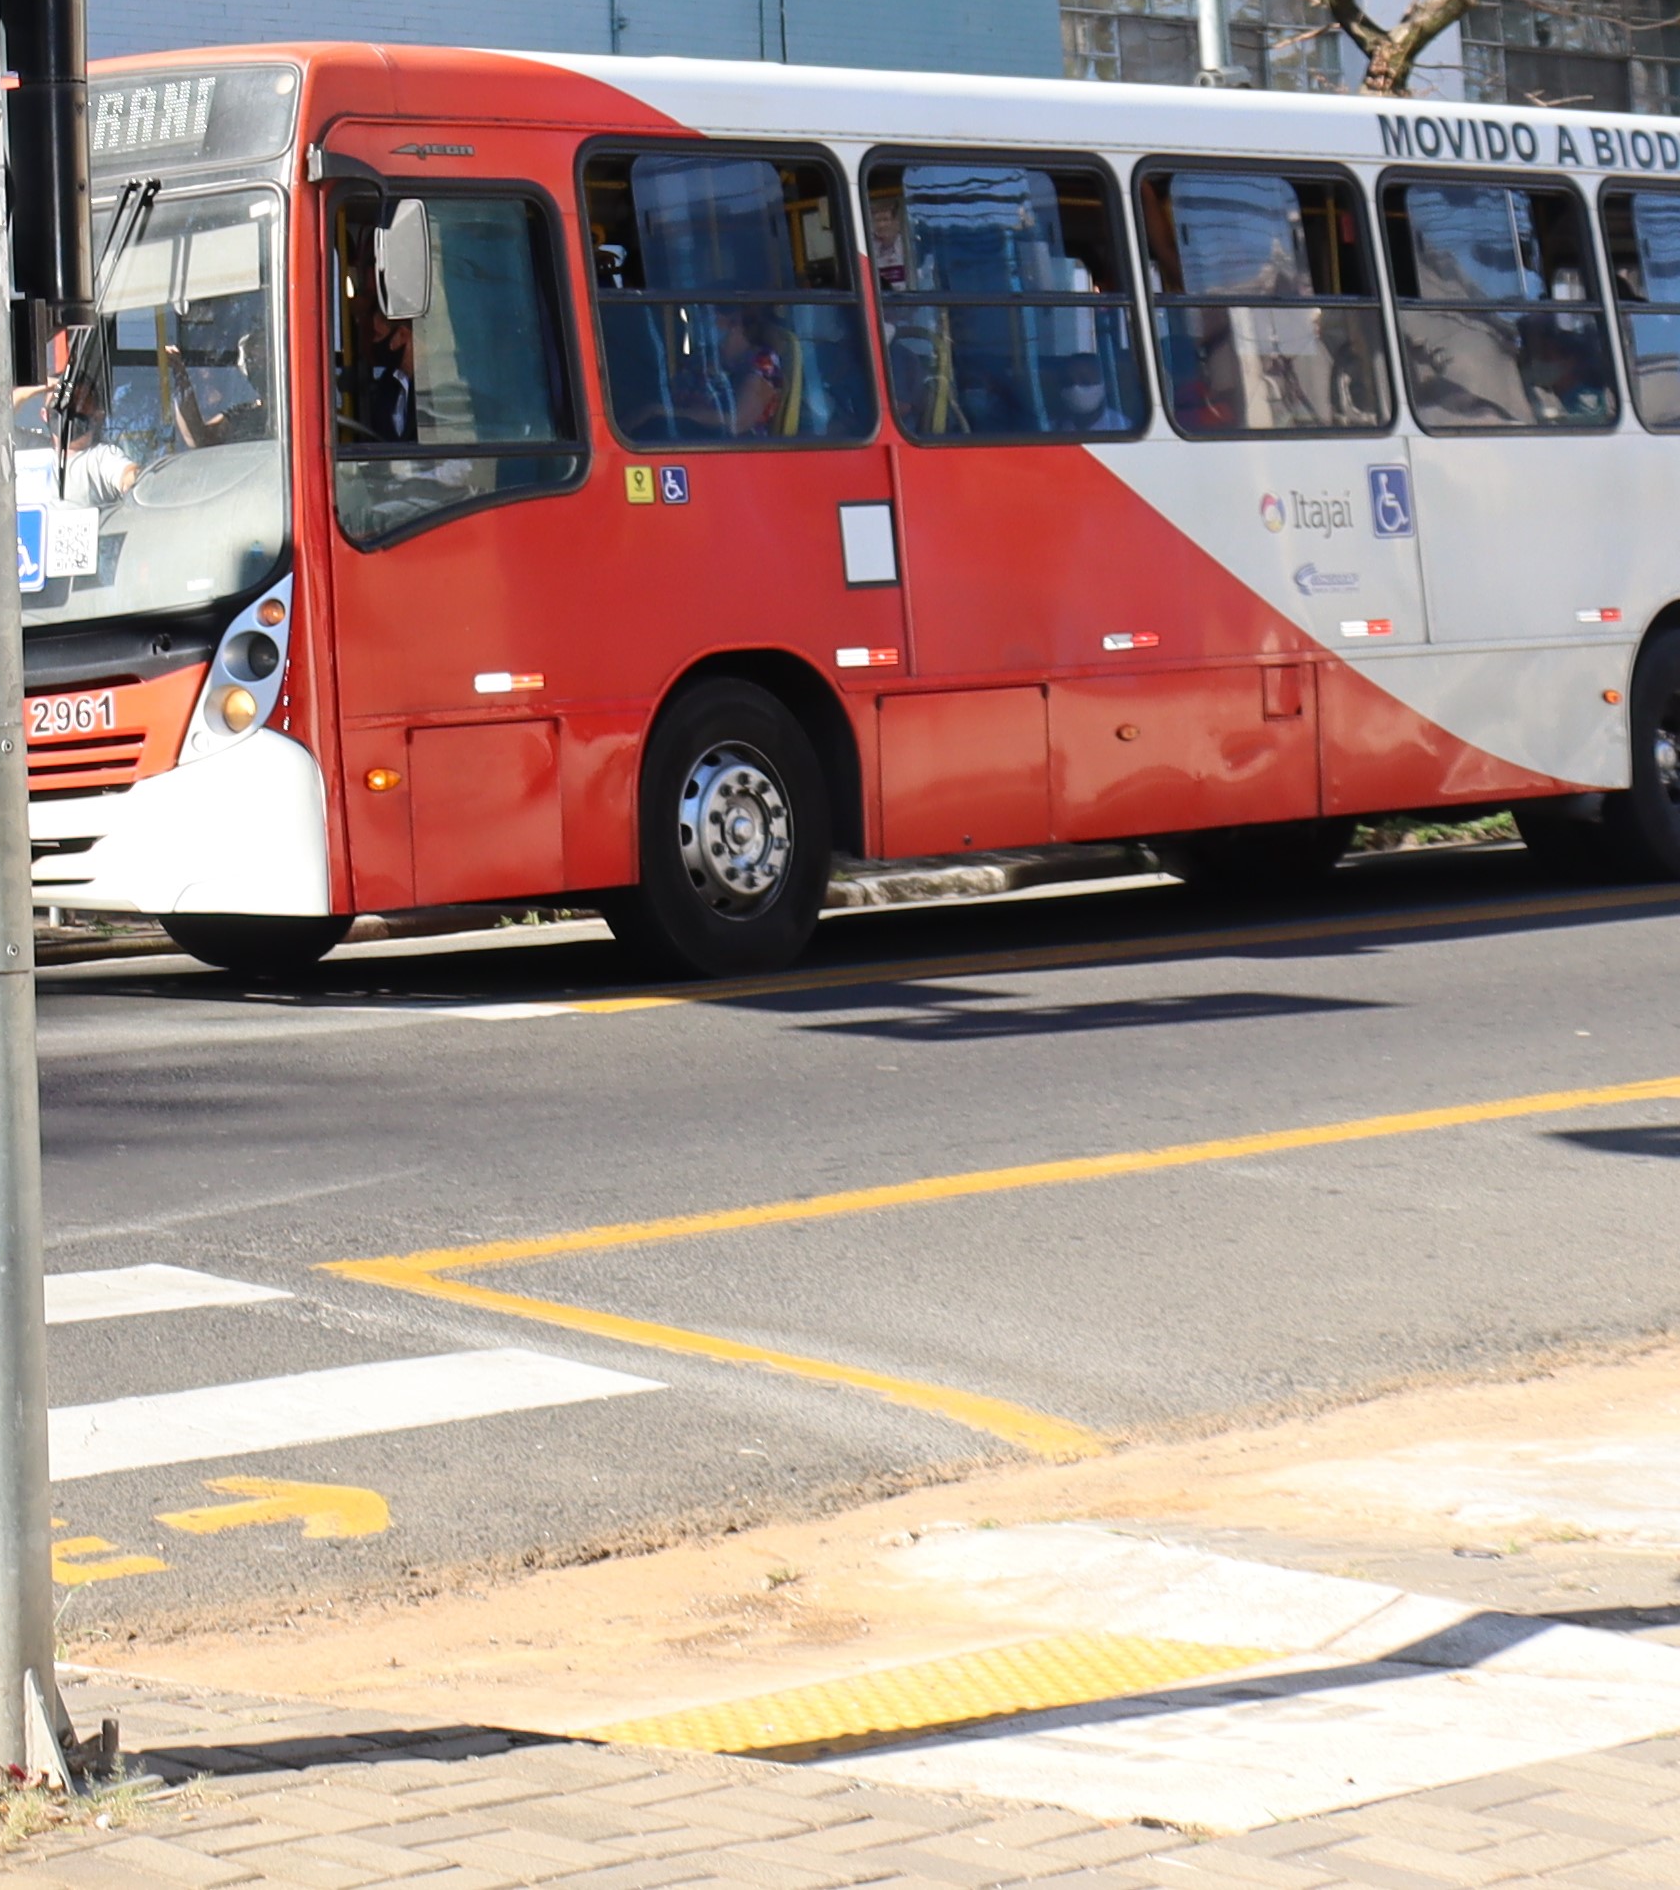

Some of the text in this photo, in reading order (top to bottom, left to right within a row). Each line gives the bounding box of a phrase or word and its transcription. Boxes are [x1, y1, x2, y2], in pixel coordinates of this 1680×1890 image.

[1376, 113, 1538, 162] MOVIDO
[1557, 124, 1583, 165] A
[1289, 490, 1354, 540] Itajaí
[31, 694, 114, 735] 2961
